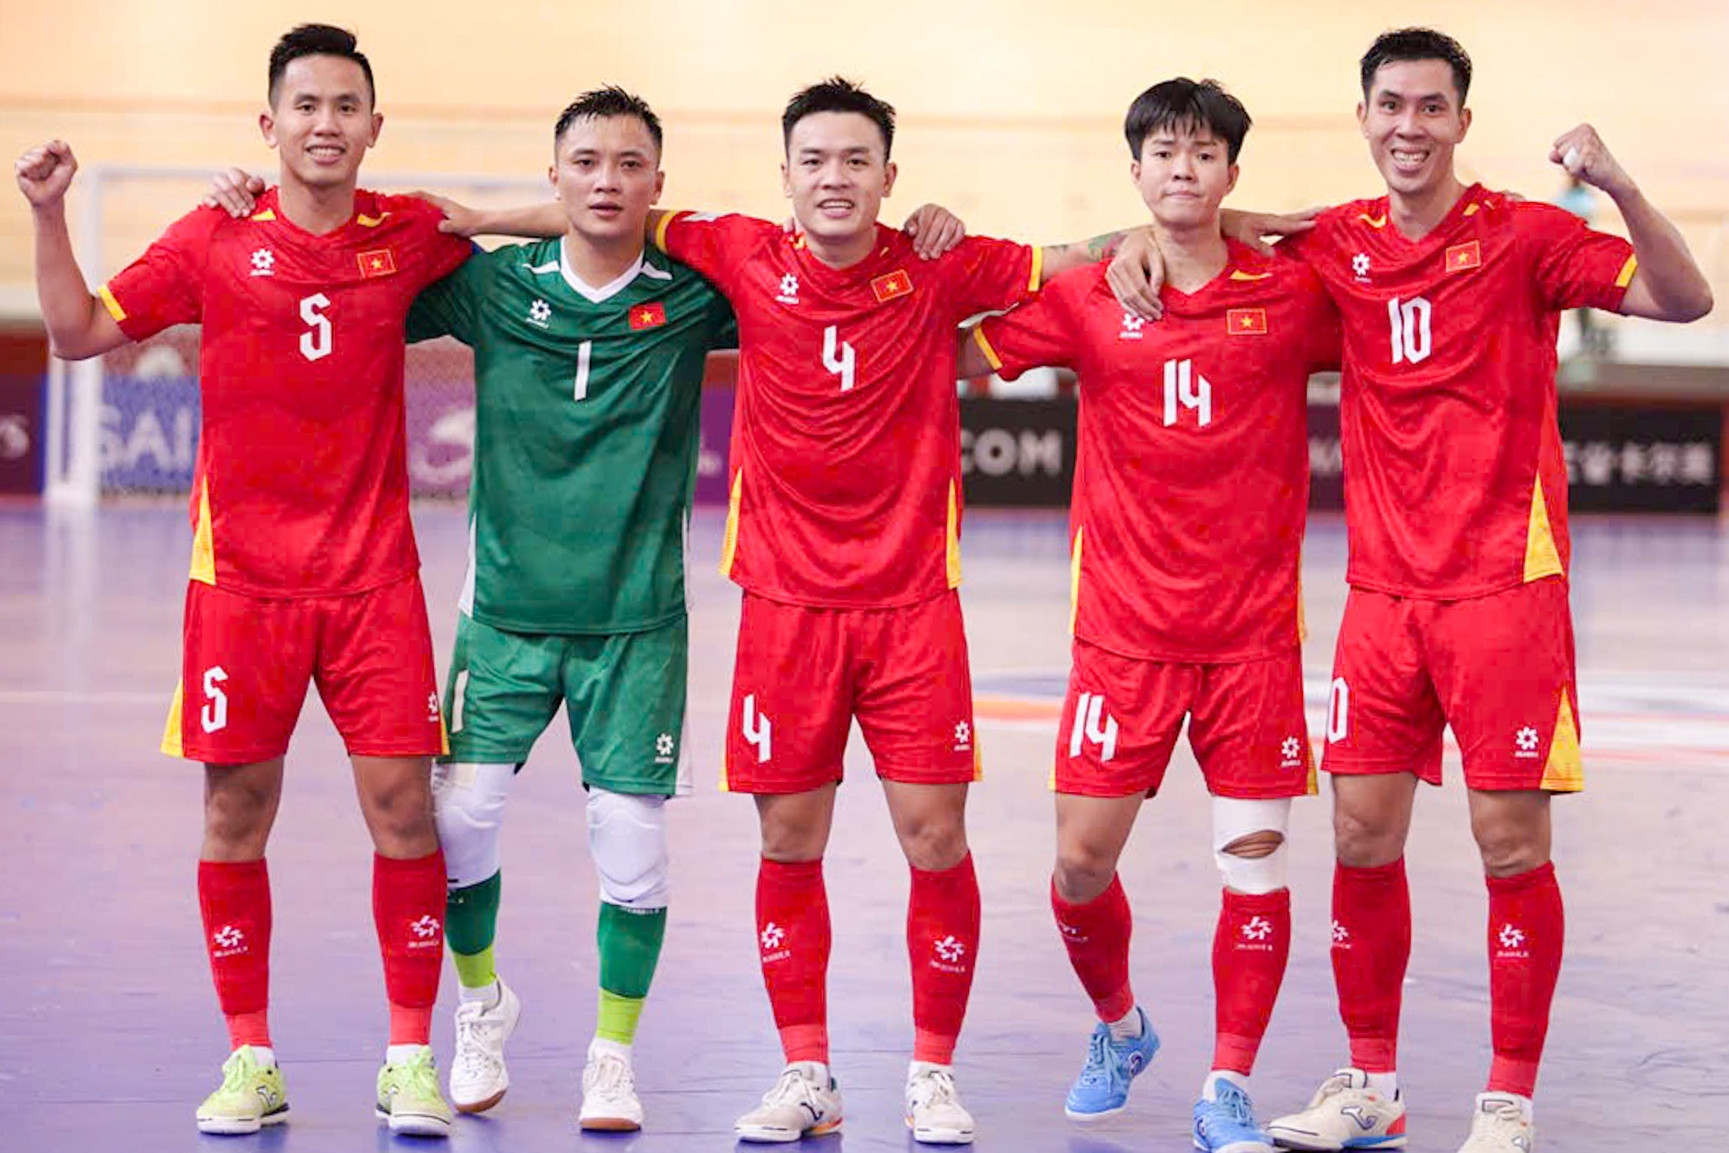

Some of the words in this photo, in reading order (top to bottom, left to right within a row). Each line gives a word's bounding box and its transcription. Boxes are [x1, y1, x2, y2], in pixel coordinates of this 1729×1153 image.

[822, 325, 855, 392] 4
[1388, 297, 1431, 364] 10
[574, 341, 592, 401] 1
[1163, 359, 1211, 427] 14
[452, 669, 469, 733] 1
[742, 694, 771, 763] 4
[1070, 692, 1119, 762] 14
